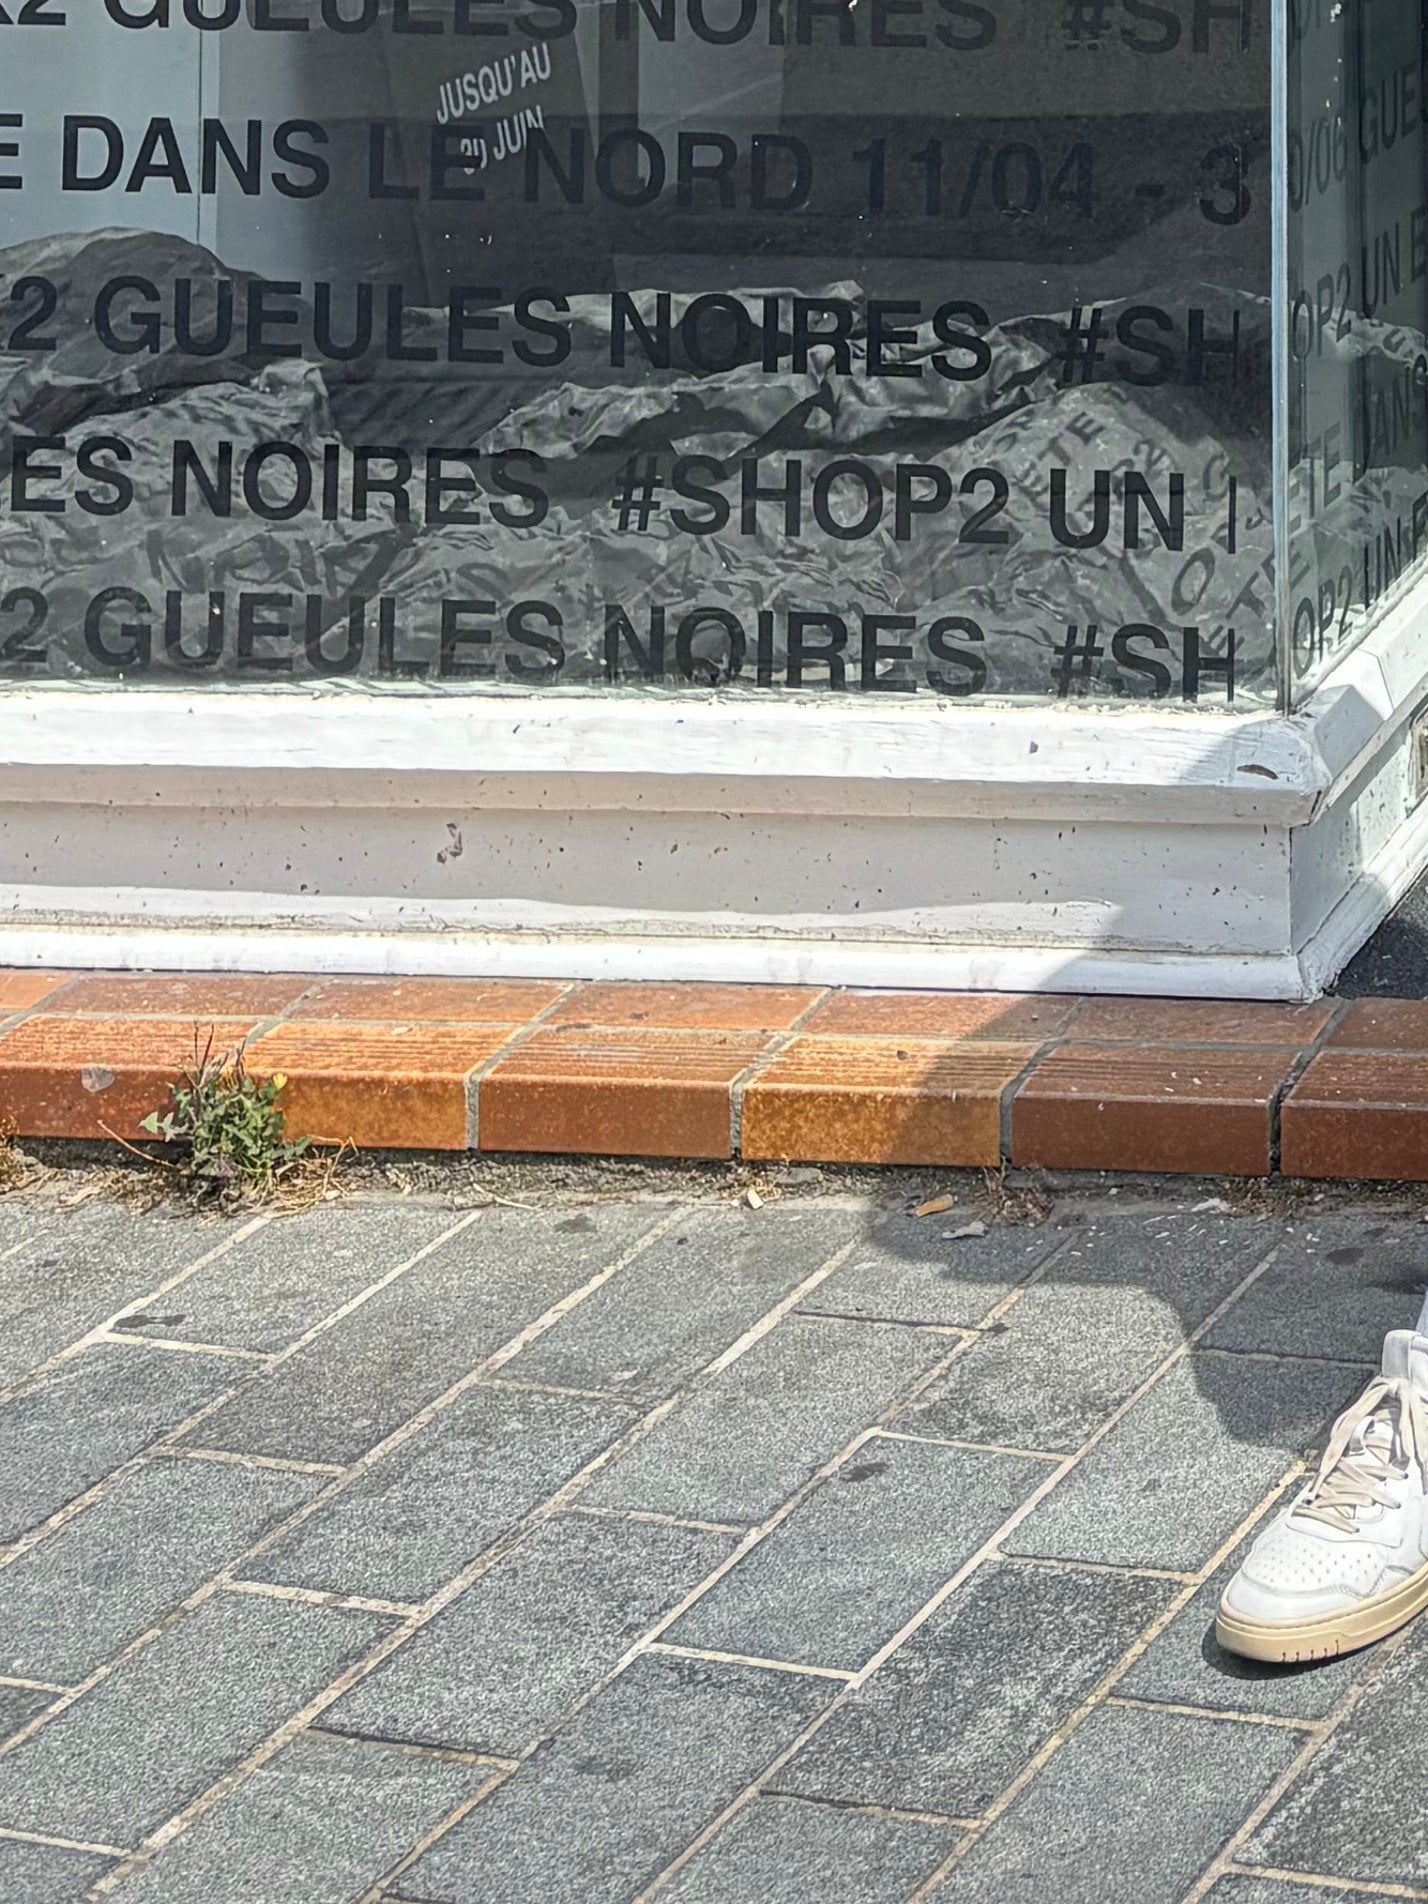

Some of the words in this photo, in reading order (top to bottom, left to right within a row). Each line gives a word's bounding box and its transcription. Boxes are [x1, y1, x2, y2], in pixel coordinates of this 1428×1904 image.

[437, 42, 550, 124] JUSQU'AU
[62, 114, 331, 198] DANS
[369, 122, 486, 201] LE
[524, 128, 814, 212] NORD
[1361, 223, 1401, 320] UN
[95, 276, 571, 367] GUEULES
[611, 291, 992, 380] NOIRES
[172, 440, 550, 527] NOIRES
[612, 455, 1009, 544] #SHOP2
[1049, 468, 1184, 552] UN
[85, 587, 565, 676] GUEULES
[605, 604, 987, 695] NOIRES
